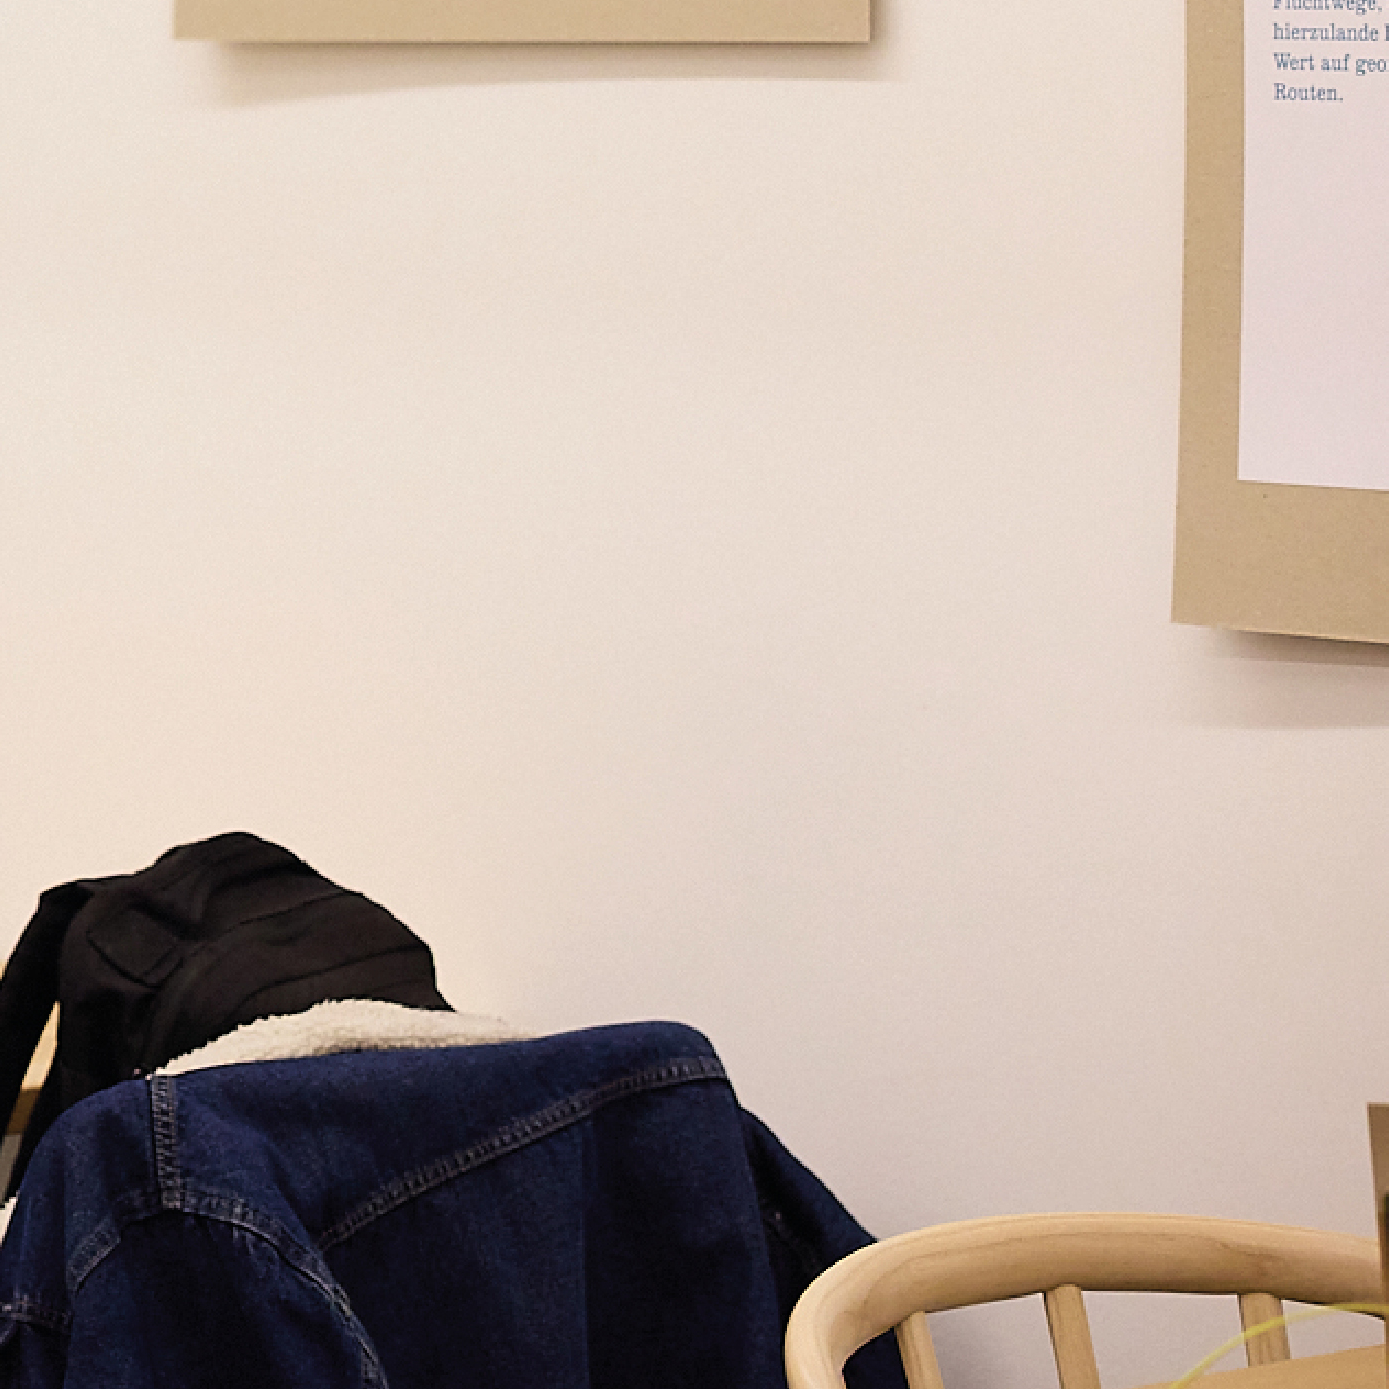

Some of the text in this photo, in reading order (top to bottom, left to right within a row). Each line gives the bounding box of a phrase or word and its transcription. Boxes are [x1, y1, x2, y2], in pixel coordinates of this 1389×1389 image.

[1272, 22, 1379, 42] hierzulande
[1273, 52, 1389, 76] Wert auf geo
[1273, 83, 1343, 103] Routen.
